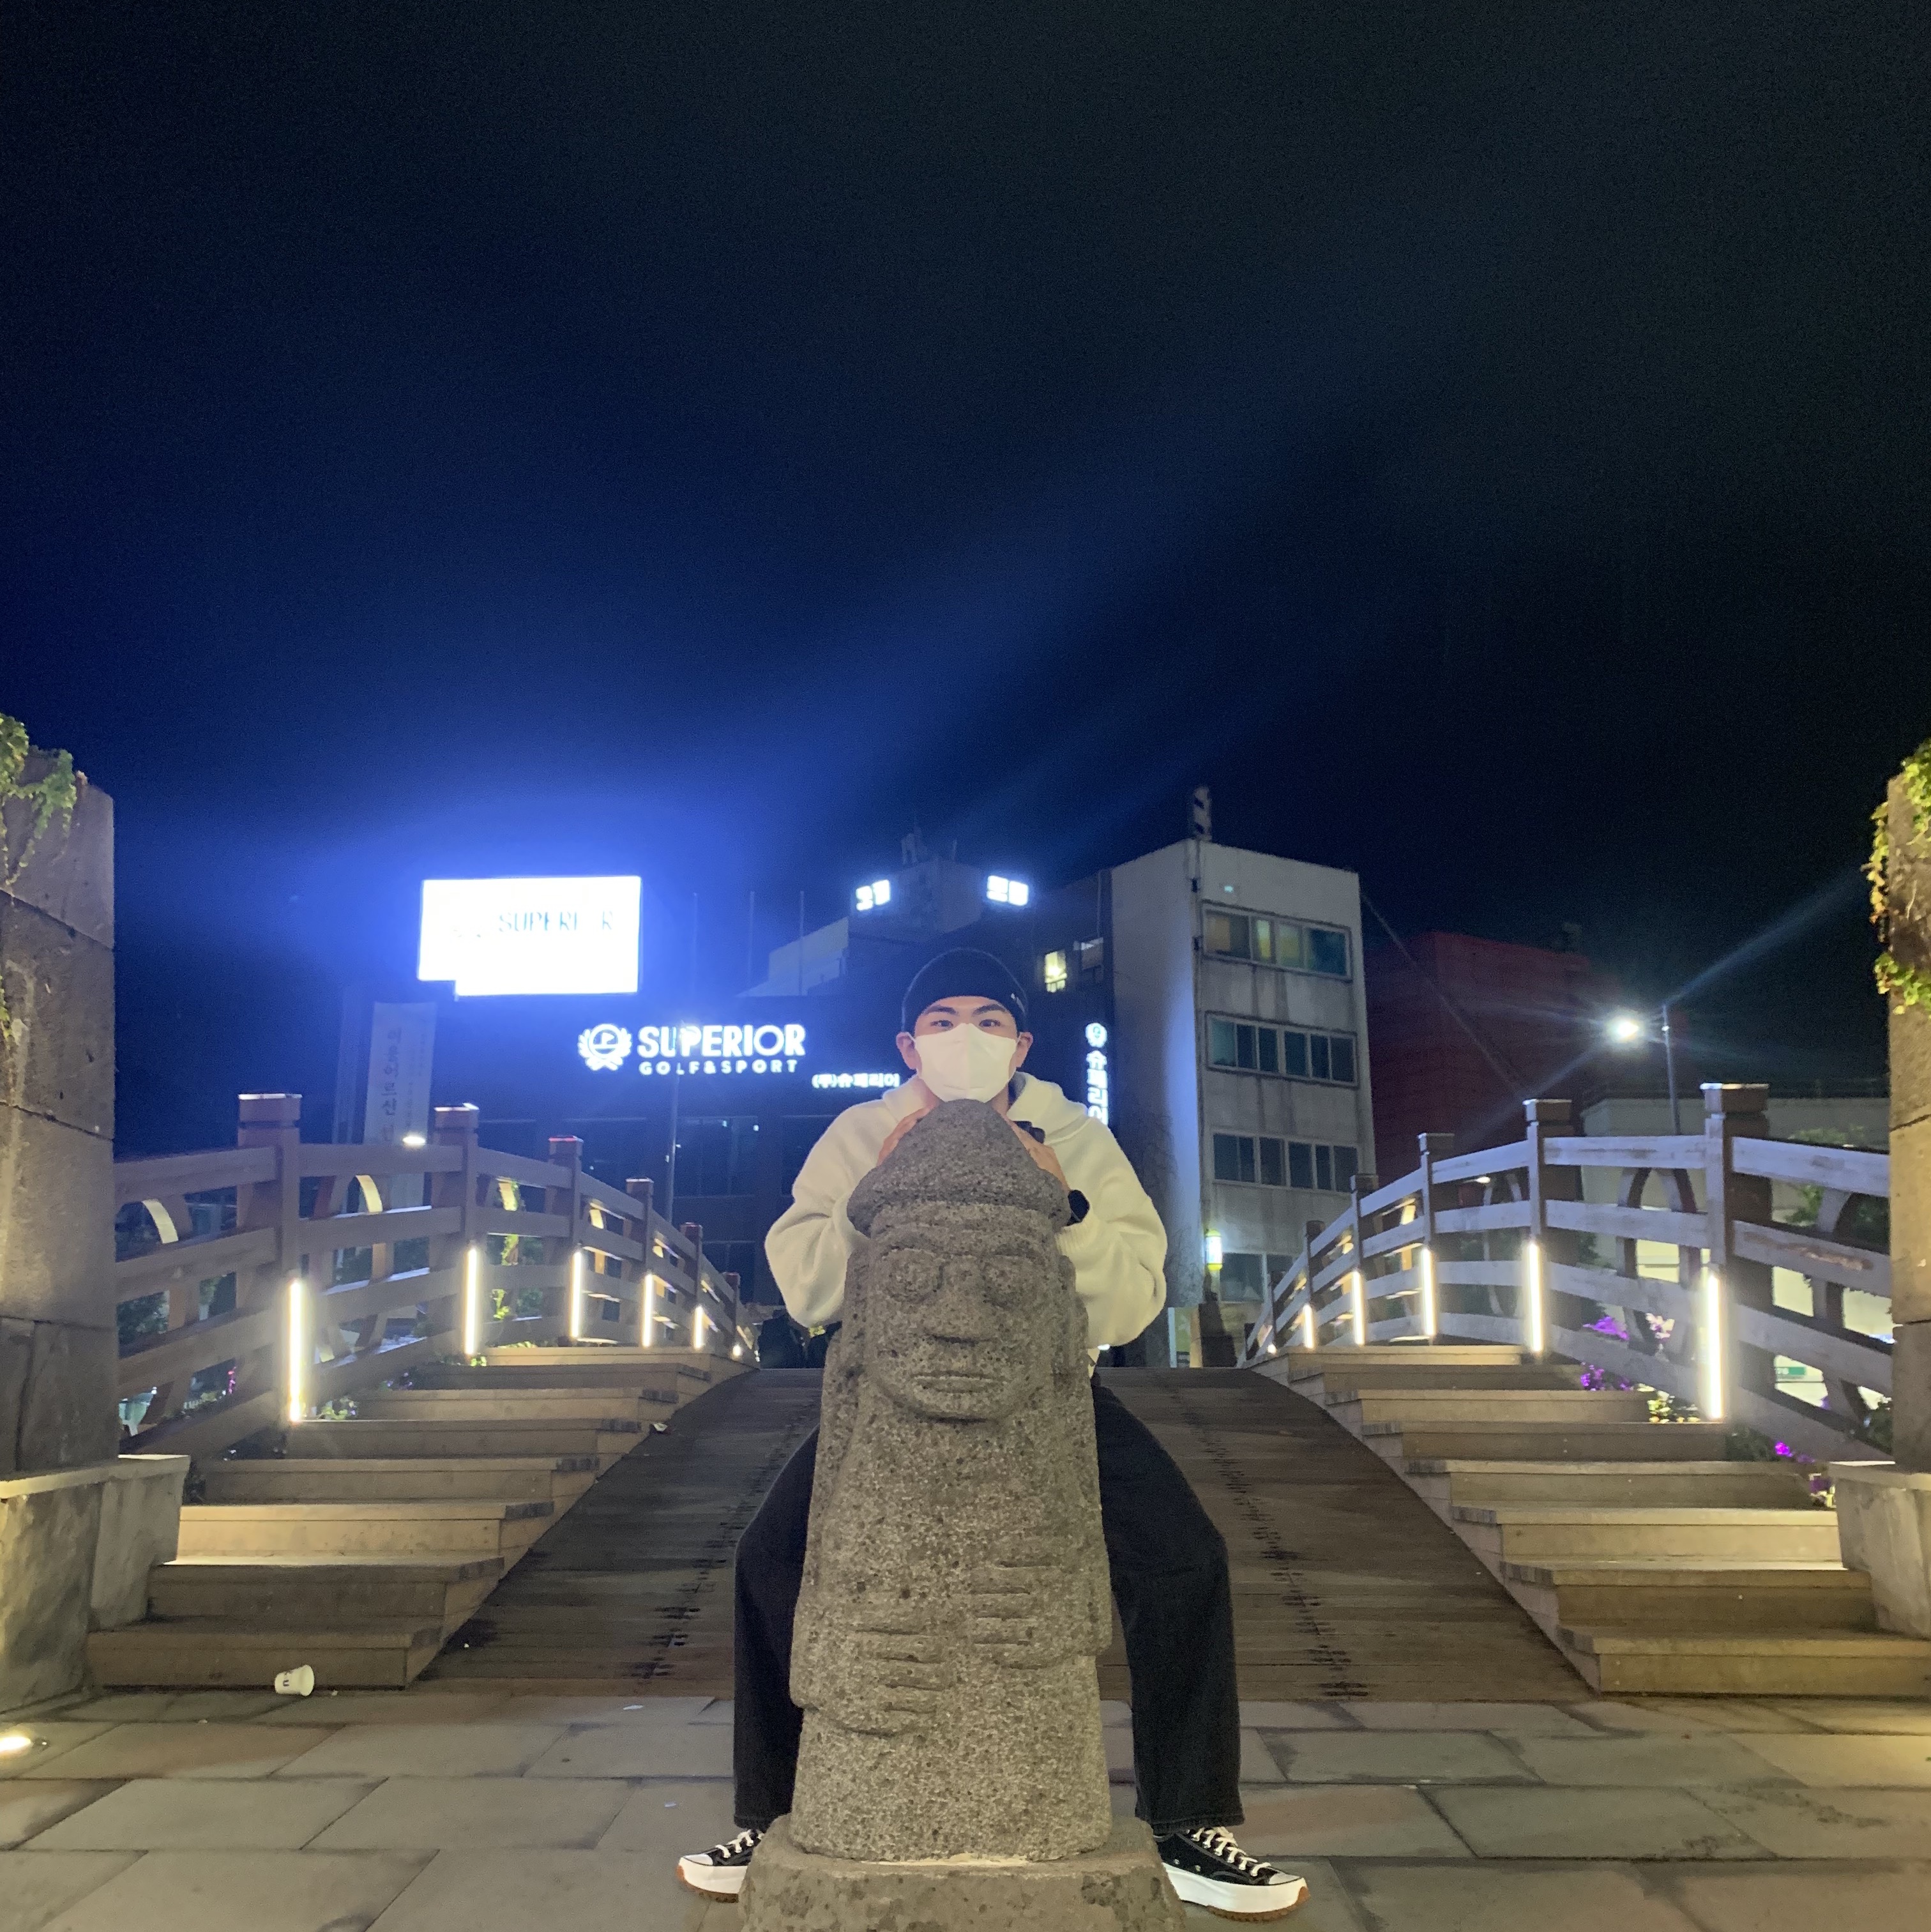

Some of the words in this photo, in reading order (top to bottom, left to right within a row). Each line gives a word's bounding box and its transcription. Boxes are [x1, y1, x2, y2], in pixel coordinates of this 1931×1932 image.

[497, 909, 614, 932] SUPERIR
[637, 1024, 806, 1058] SUPERIOR
[639, 1060, 798, 1076] GOLF&SPORT
